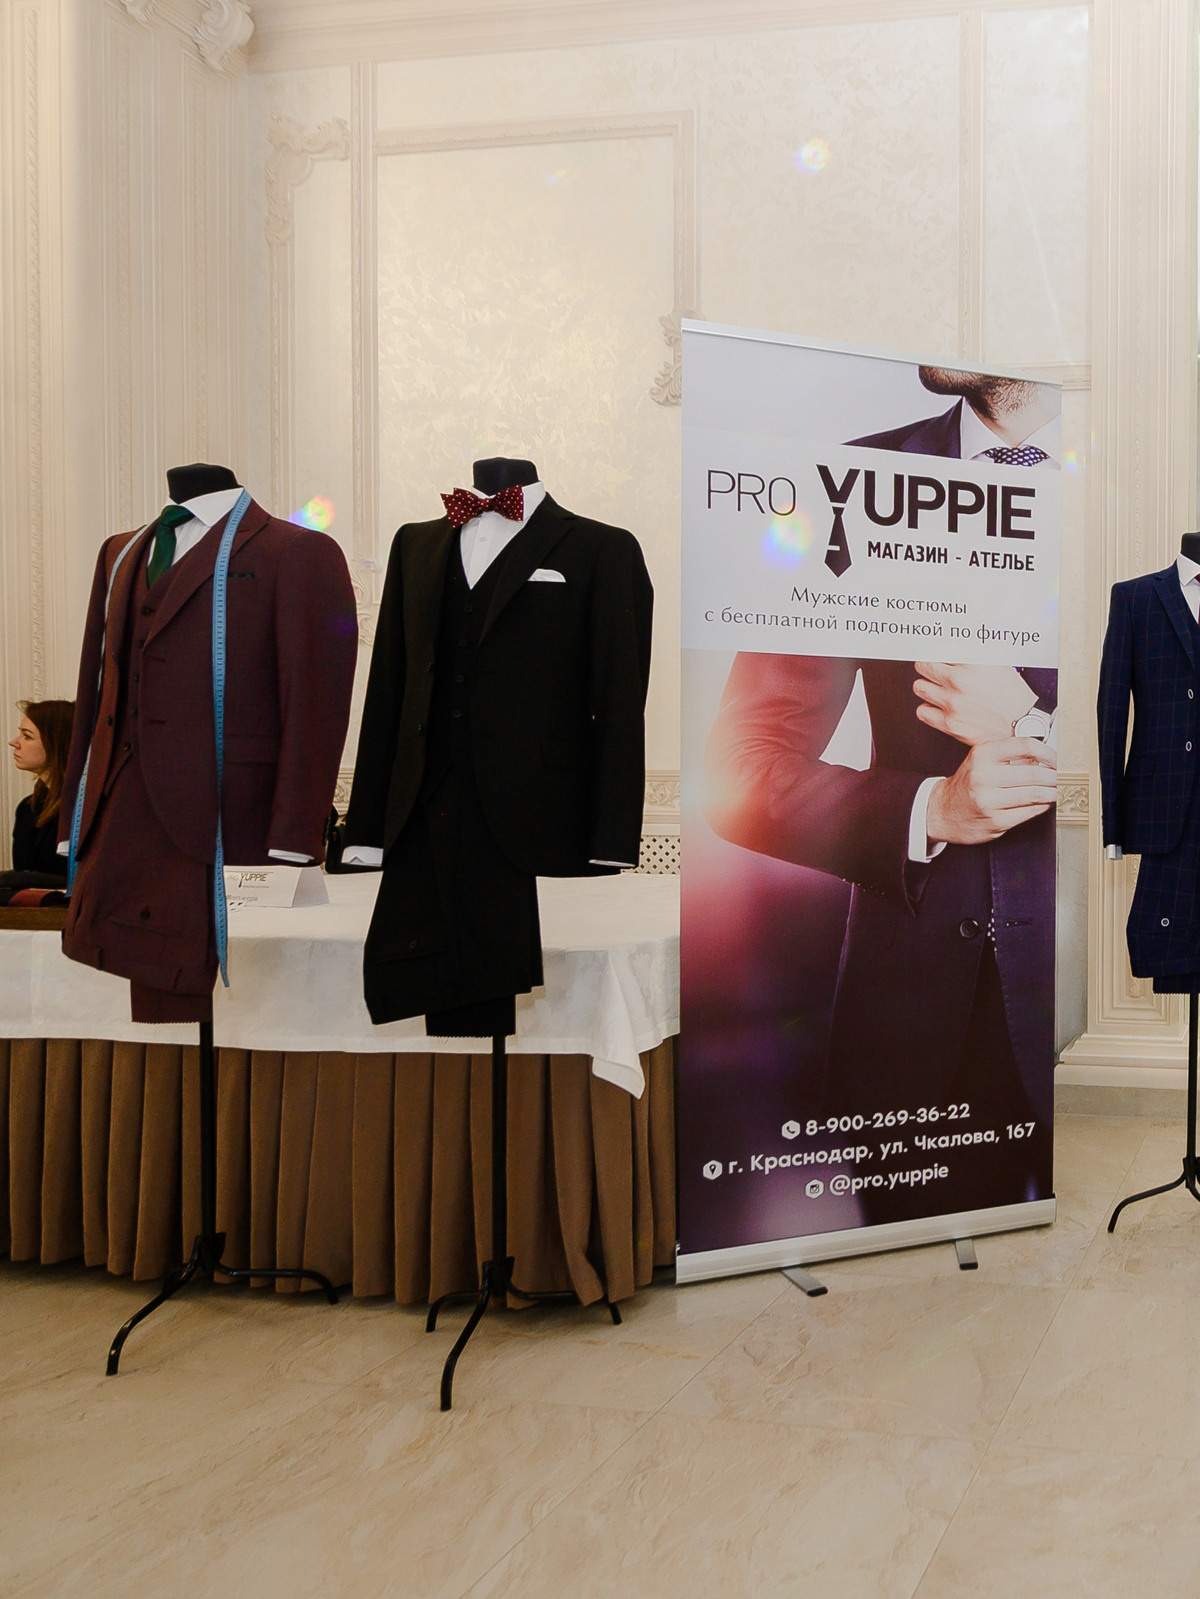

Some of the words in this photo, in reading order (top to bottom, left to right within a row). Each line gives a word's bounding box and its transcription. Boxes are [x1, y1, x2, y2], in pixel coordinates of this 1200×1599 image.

[707, 469, 797, 516] PRO
[815, 463, 1036, 578] YUPPIE
[867, 540, 948, 565] МАГАЗИН
[968, 550, 1035, 572] АТЕЛЬЕ
[790, 586, 880, 609] Мужские
[886, 597, 968, 614] костюмы
[704, 610, 714, 622] с
[721, 606, 837, 630] бесплатной
[845, 619, 943, 637] подгонкой
[950, 627, 971, 639] по
[976, 623, 1041, 647] фигуре
[805, 1103, 971, 1136] 8-900-269-36-22
[728, 1160, 744, 1174] г.
[750, 1145, 874, 1175] Краснодар,
[879, 1141, 908, 1161] ул.
[914, 1130, 1000, 1150] Чкалова,
[1006, 1122, 1037, 1140] 167
[829, 1163, 949, 1196] @pro.yuppie
